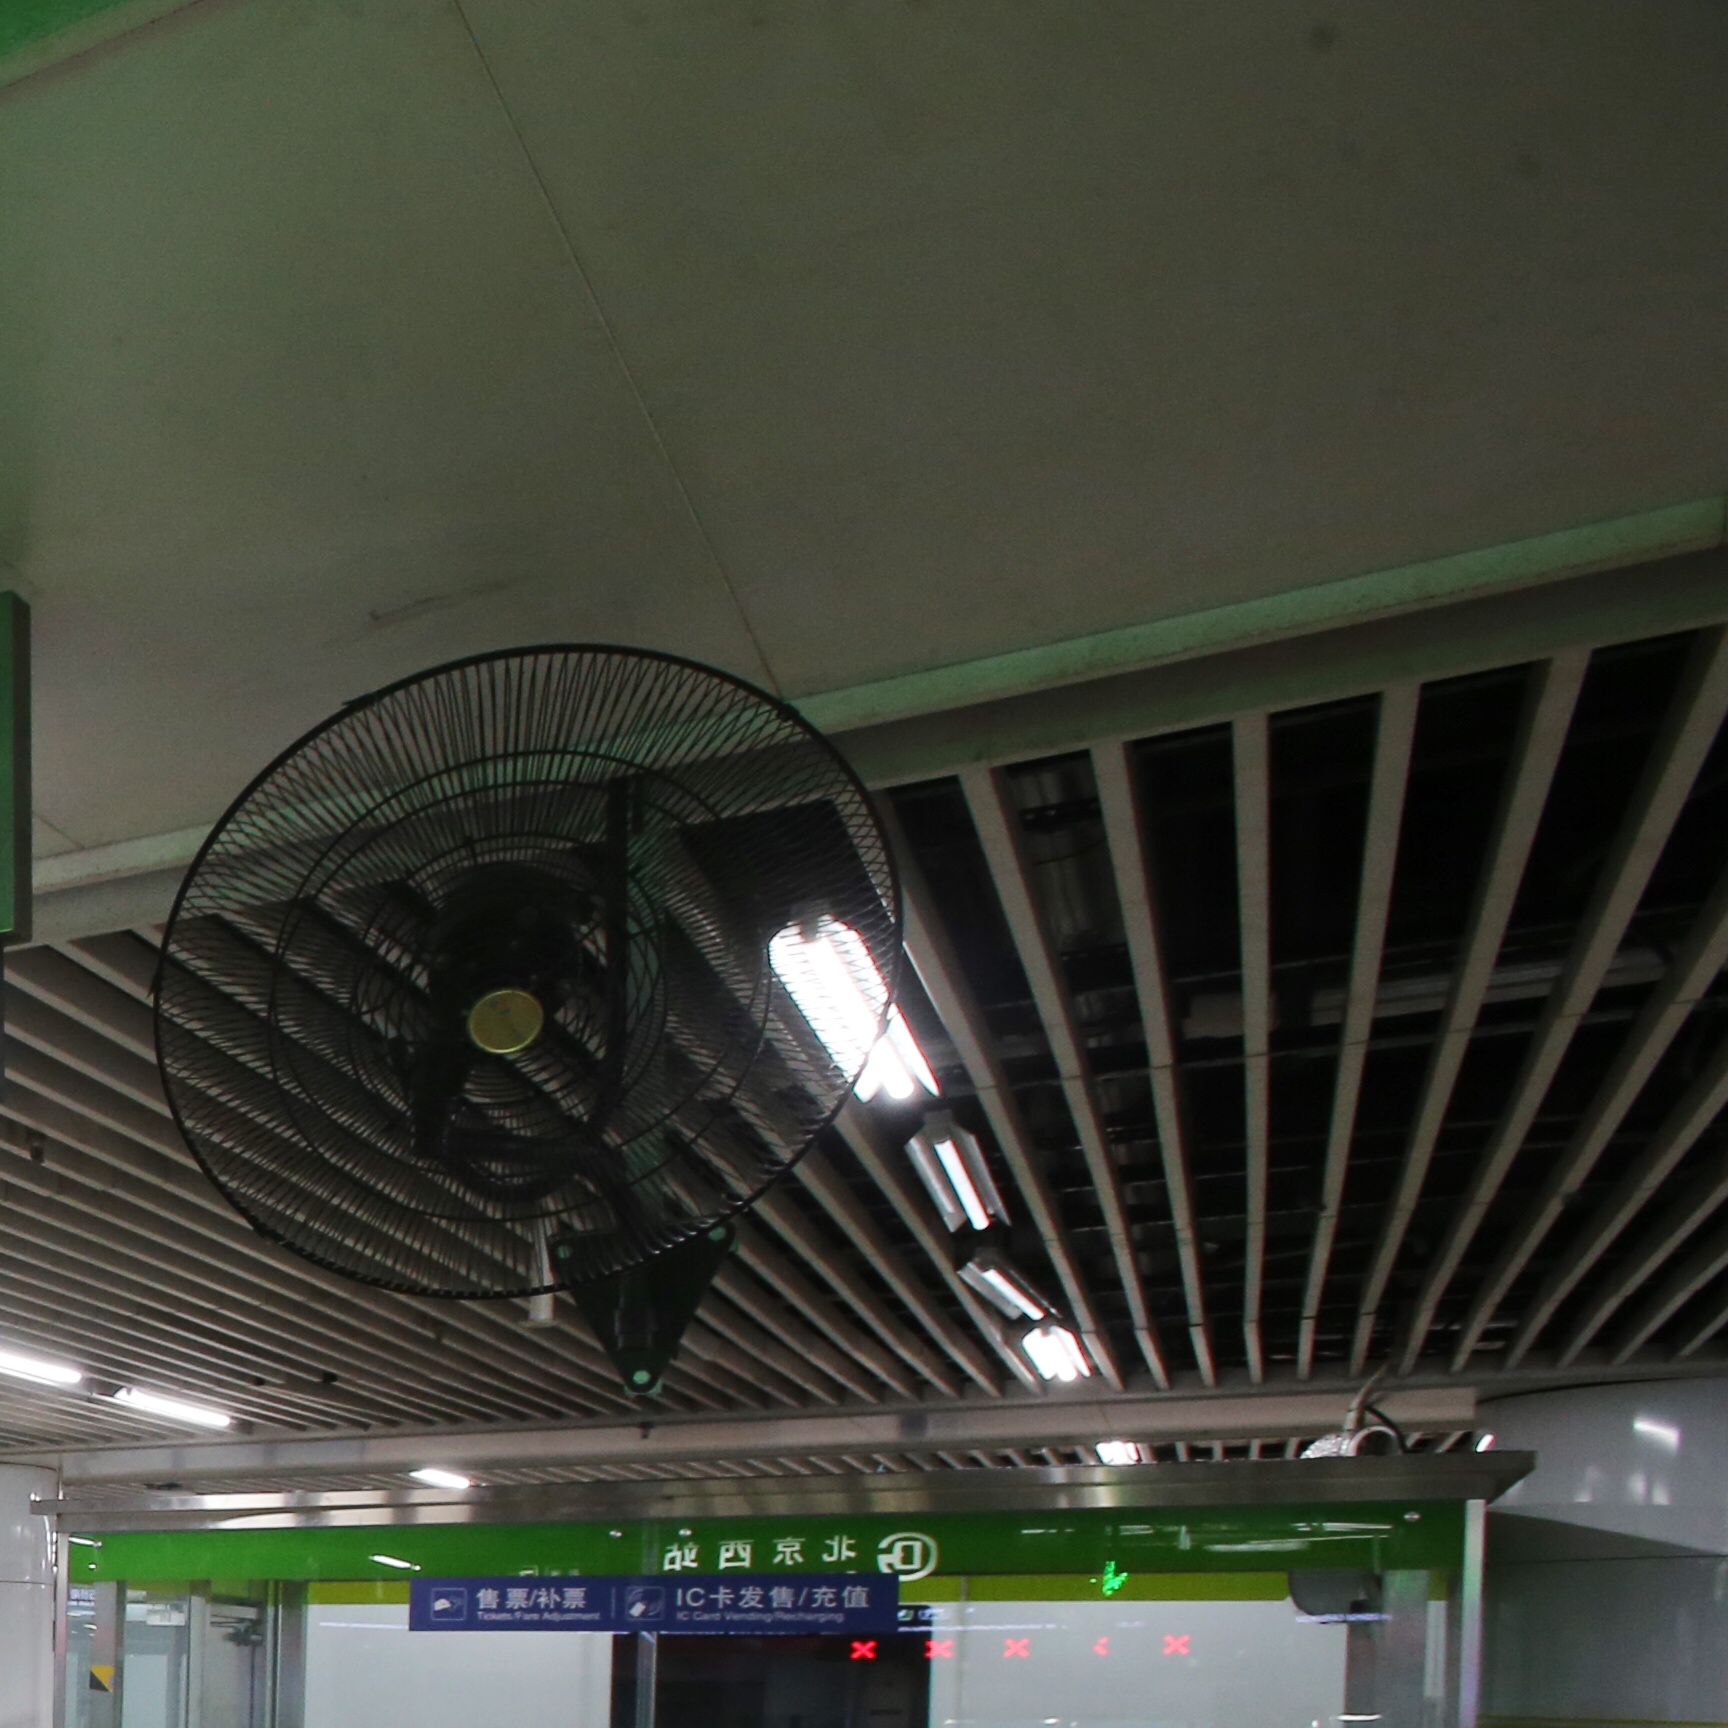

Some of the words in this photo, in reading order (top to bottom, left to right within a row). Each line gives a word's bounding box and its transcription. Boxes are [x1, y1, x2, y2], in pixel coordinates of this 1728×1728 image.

[476, 1587, 587, 1609] 售票/补票
[676, 1585, 870, 1608] IC卡发售/充值
